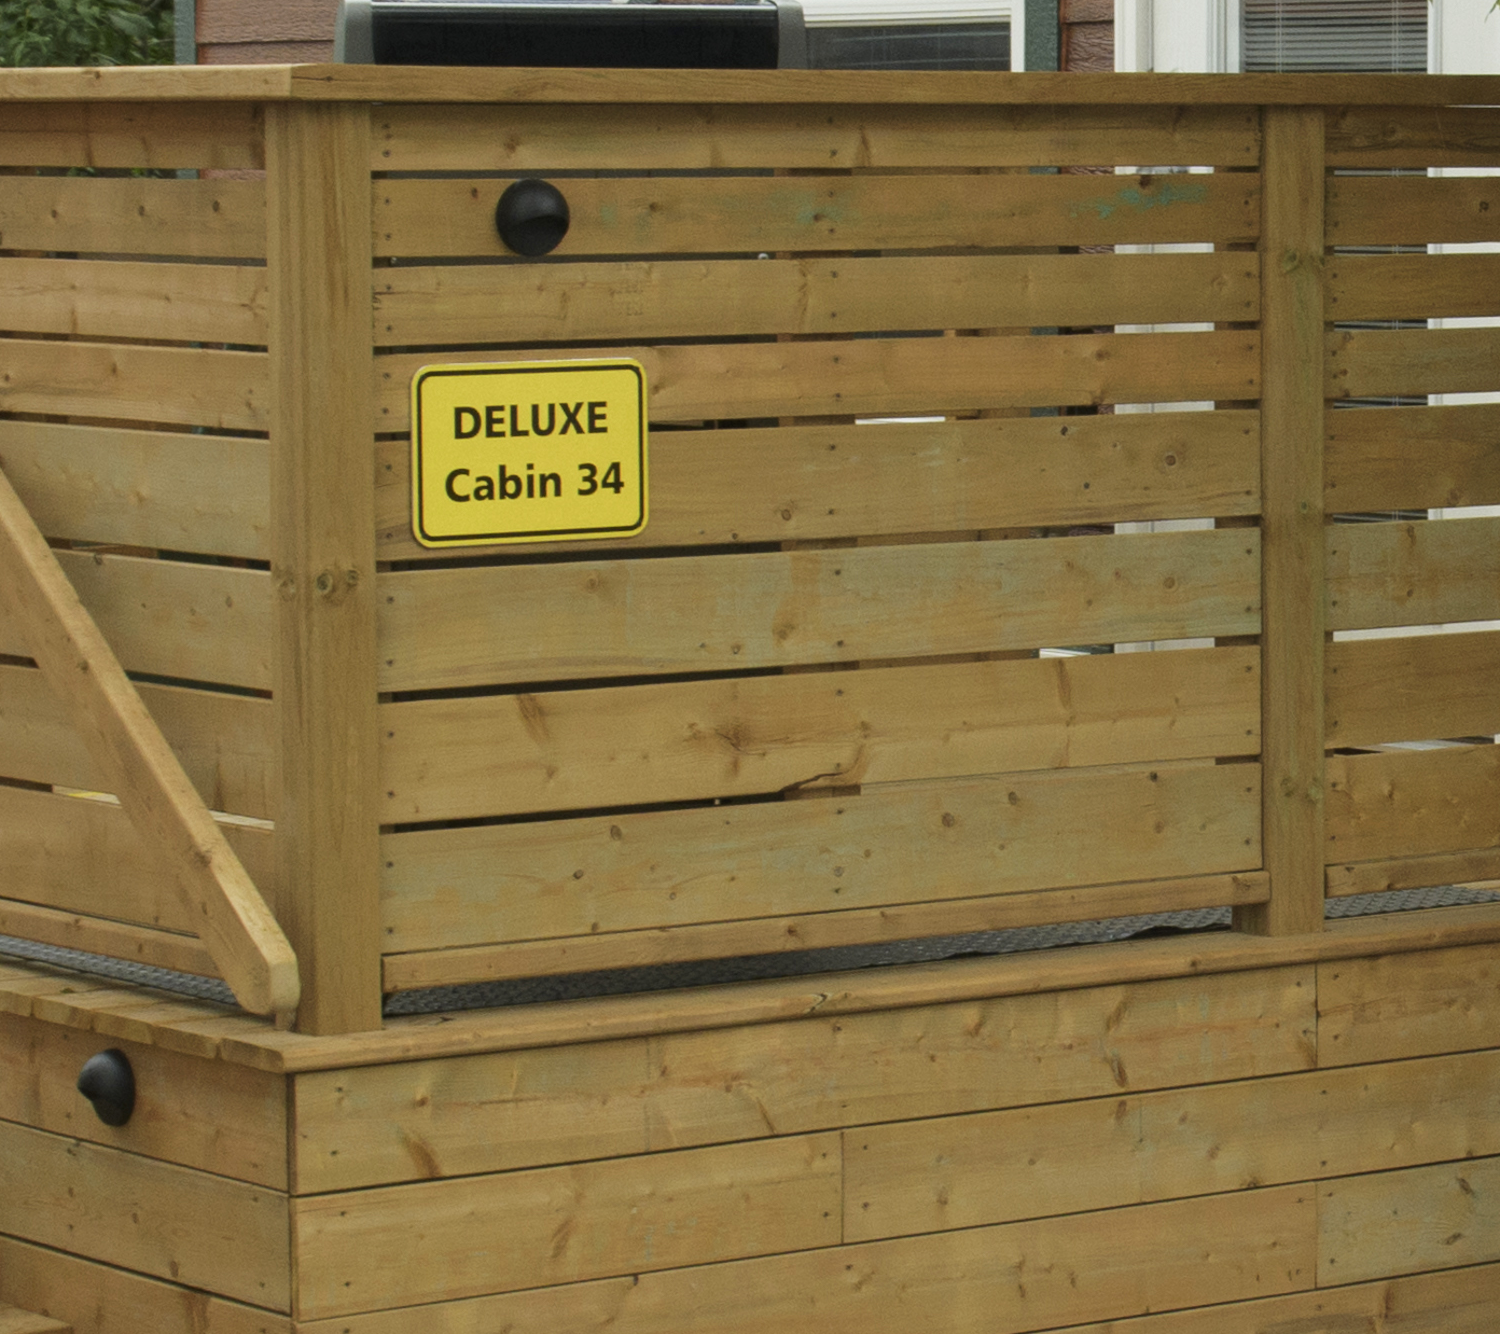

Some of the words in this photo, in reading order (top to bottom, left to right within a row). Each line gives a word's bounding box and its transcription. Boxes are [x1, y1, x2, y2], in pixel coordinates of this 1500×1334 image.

[453, 401, 608, 440] DELUXE
[445, 464, 562, 503] Cabin
[577, 462, 625, 496] 34
